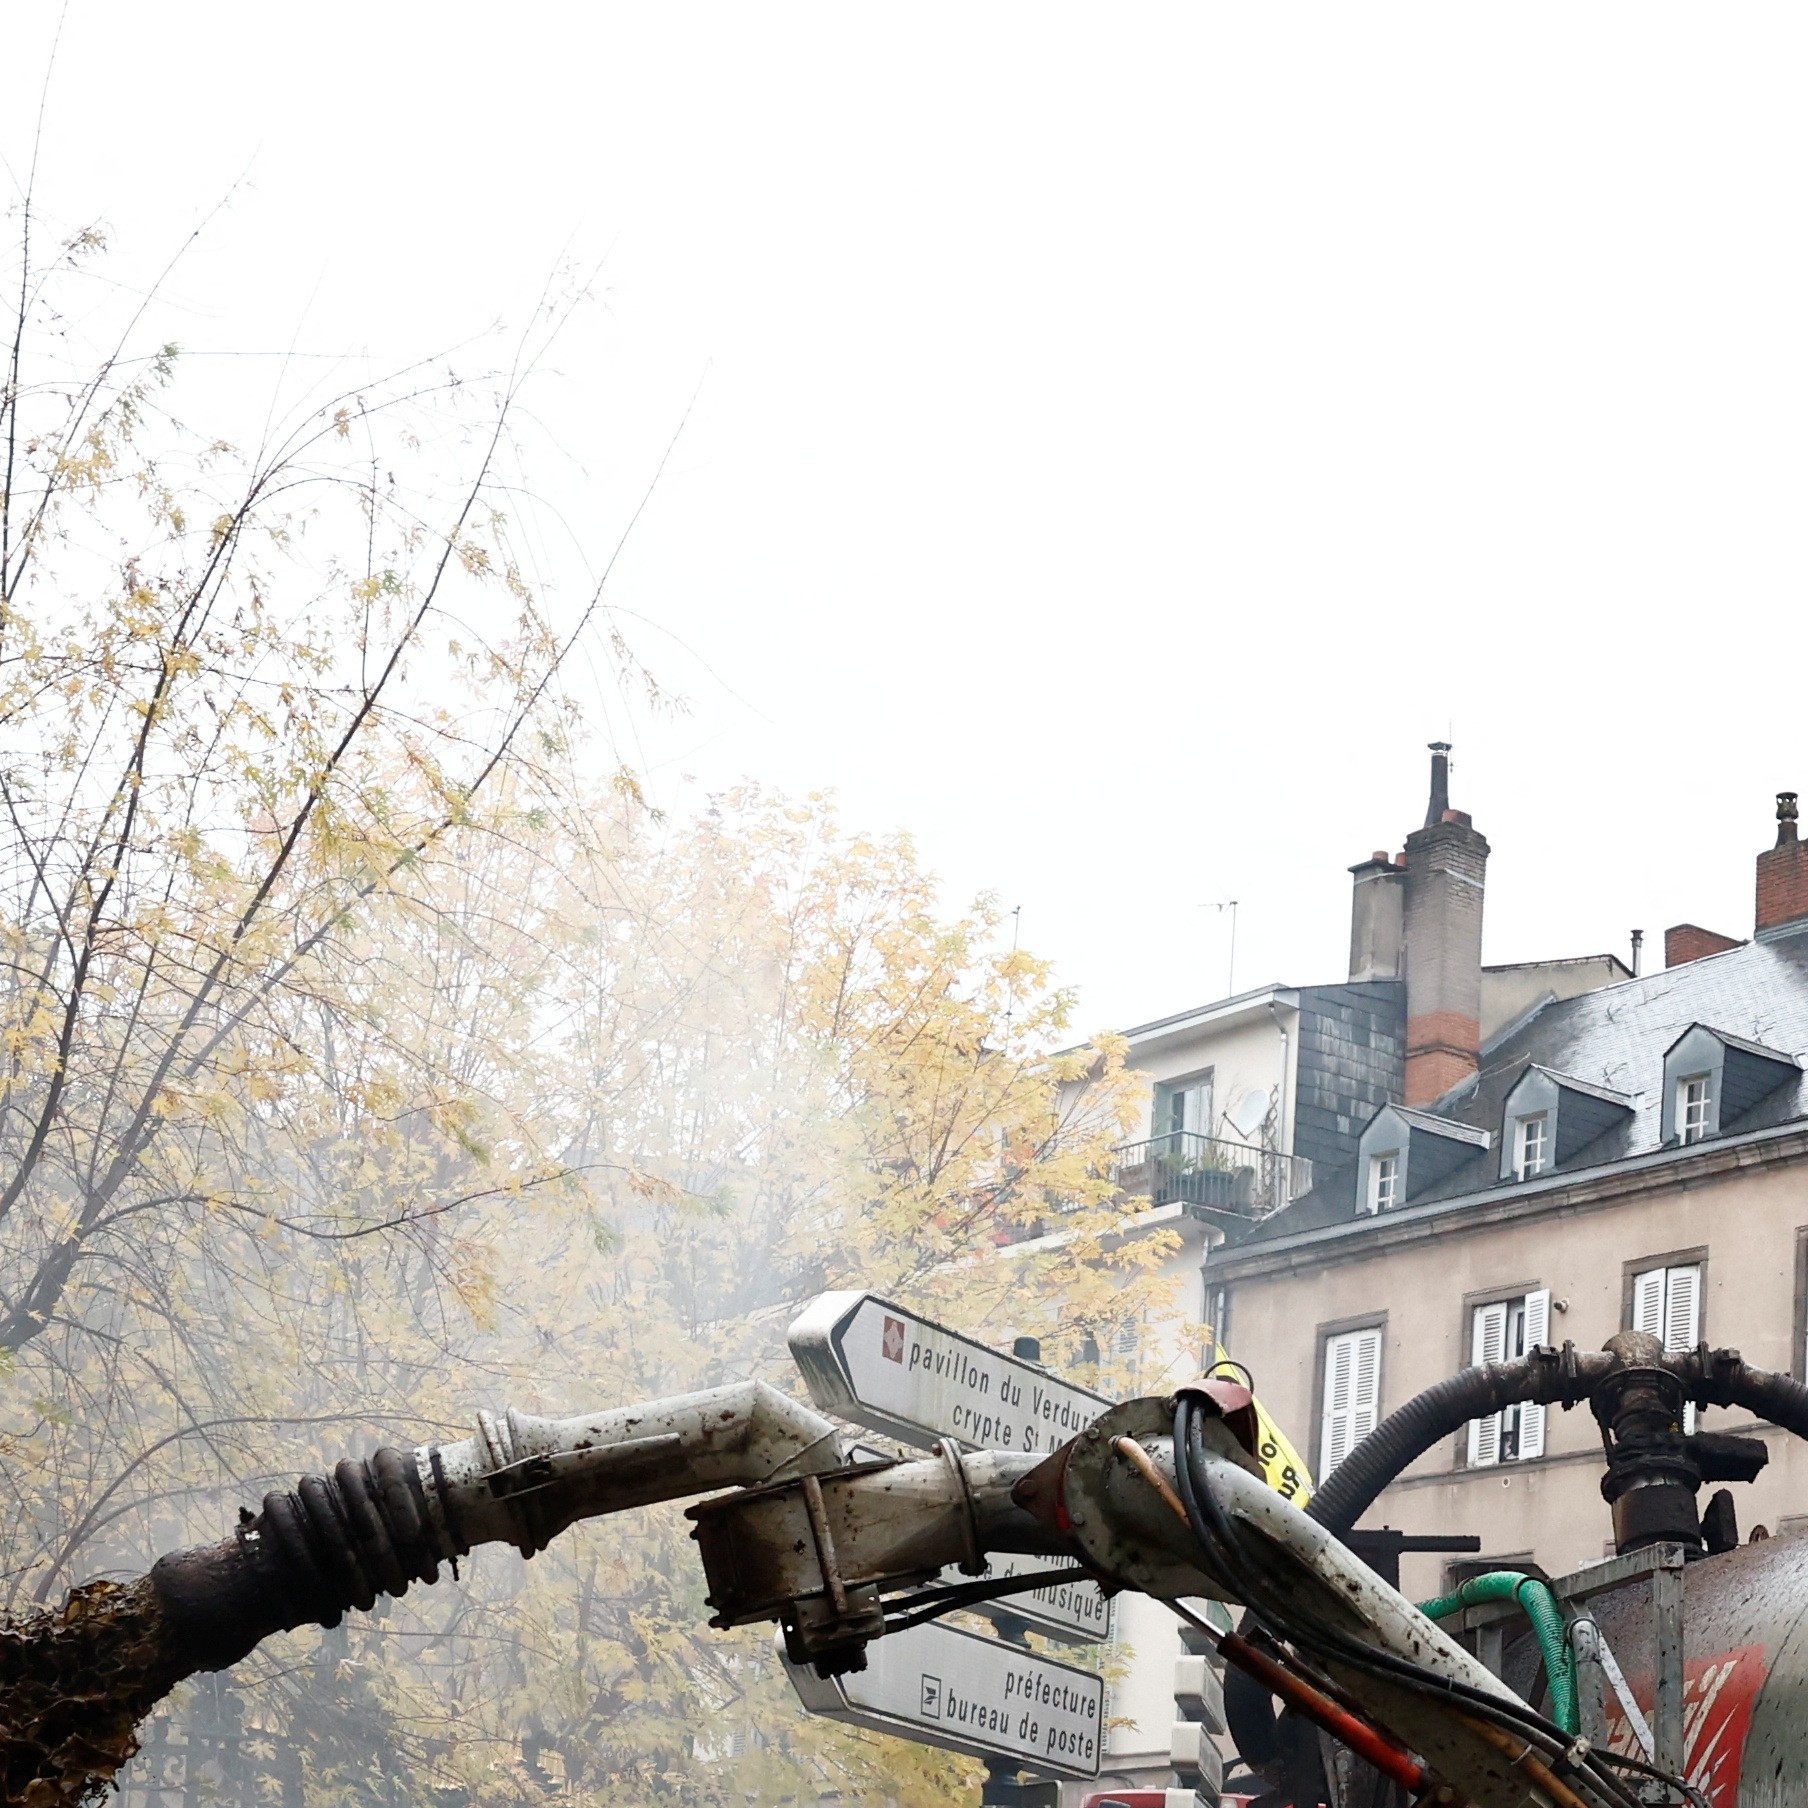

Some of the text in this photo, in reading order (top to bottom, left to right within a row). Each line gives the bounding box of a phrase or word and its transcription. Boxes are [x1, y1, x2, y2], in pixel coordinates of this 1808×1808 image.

[909, 1342, 1095, 1430] pavillon du Verdur
[953, 1404, 1011, 1446] crypte
[1033, 1584, 1103, 1622] musique
[1004, 1670, 1096, 1719] préfecture
[947, 1688, 1094, 1760] bureau de poste
